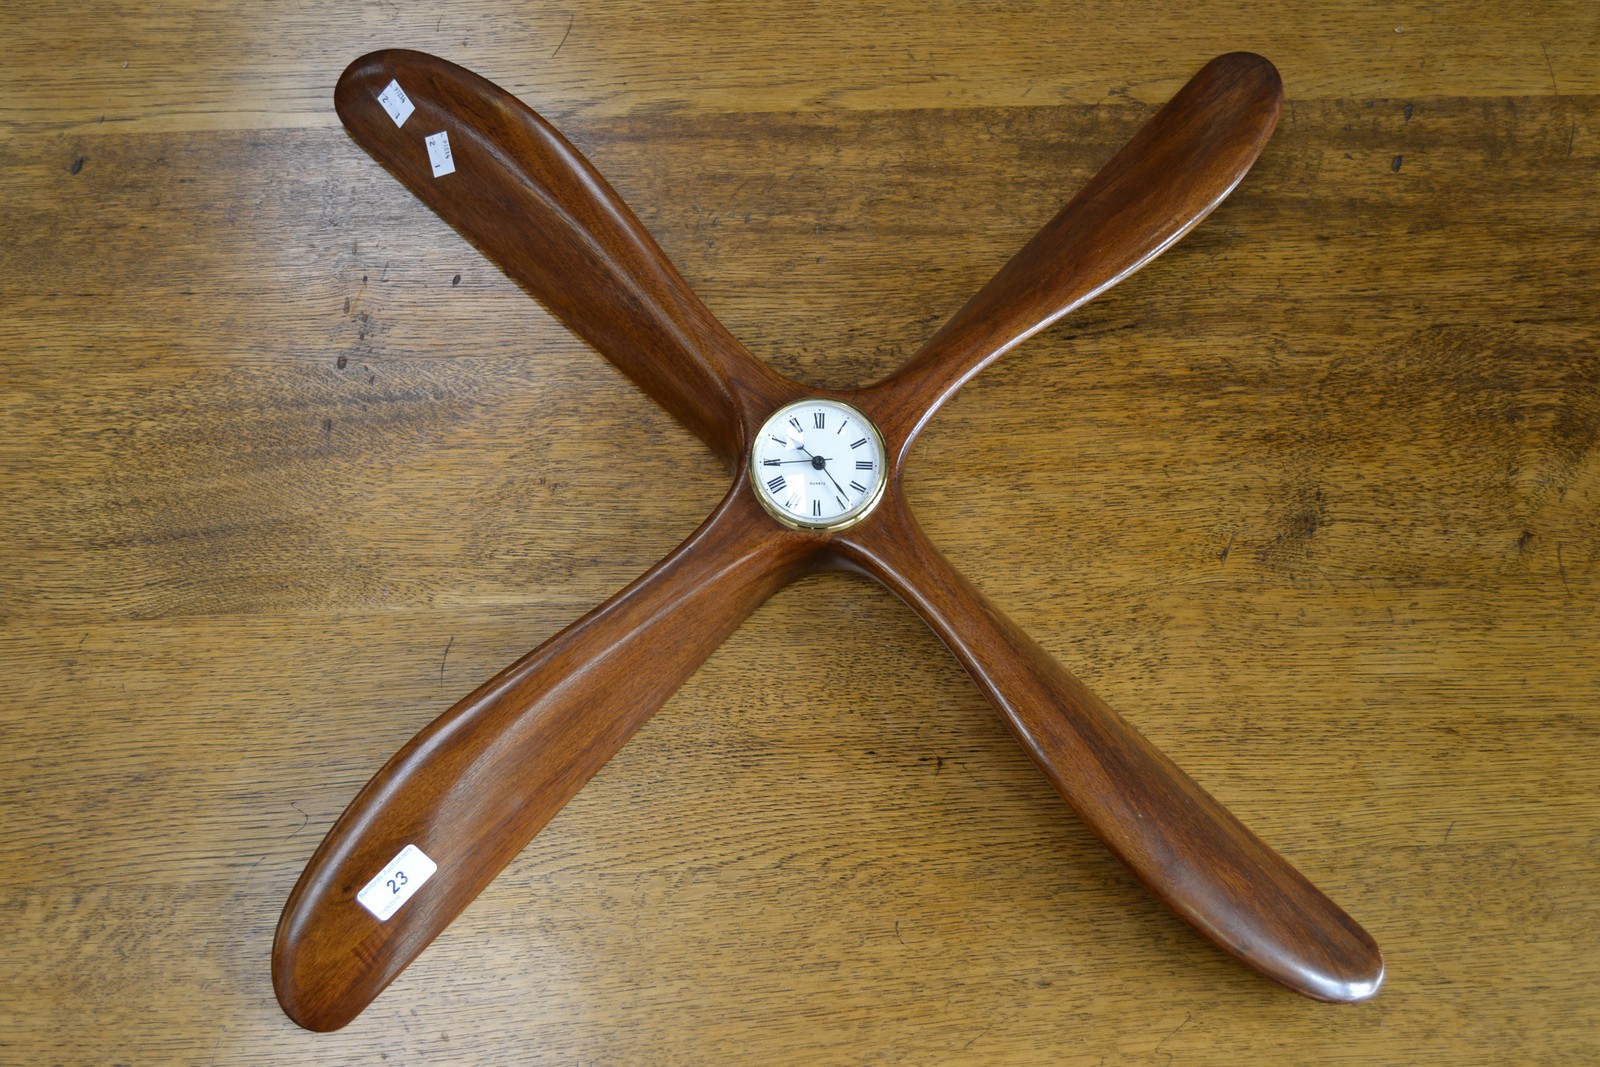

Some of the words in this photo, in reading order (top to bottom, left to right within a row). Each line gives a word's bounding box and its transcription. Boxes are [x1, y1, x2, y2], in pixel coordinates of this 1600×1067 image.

[813, 412, 825, 429] XII
[850, 438, 868, 450] II
[856, 460, 873, 470] III
[812, 500, 821, 516] VI
[386, 871, 408, 894] 23
